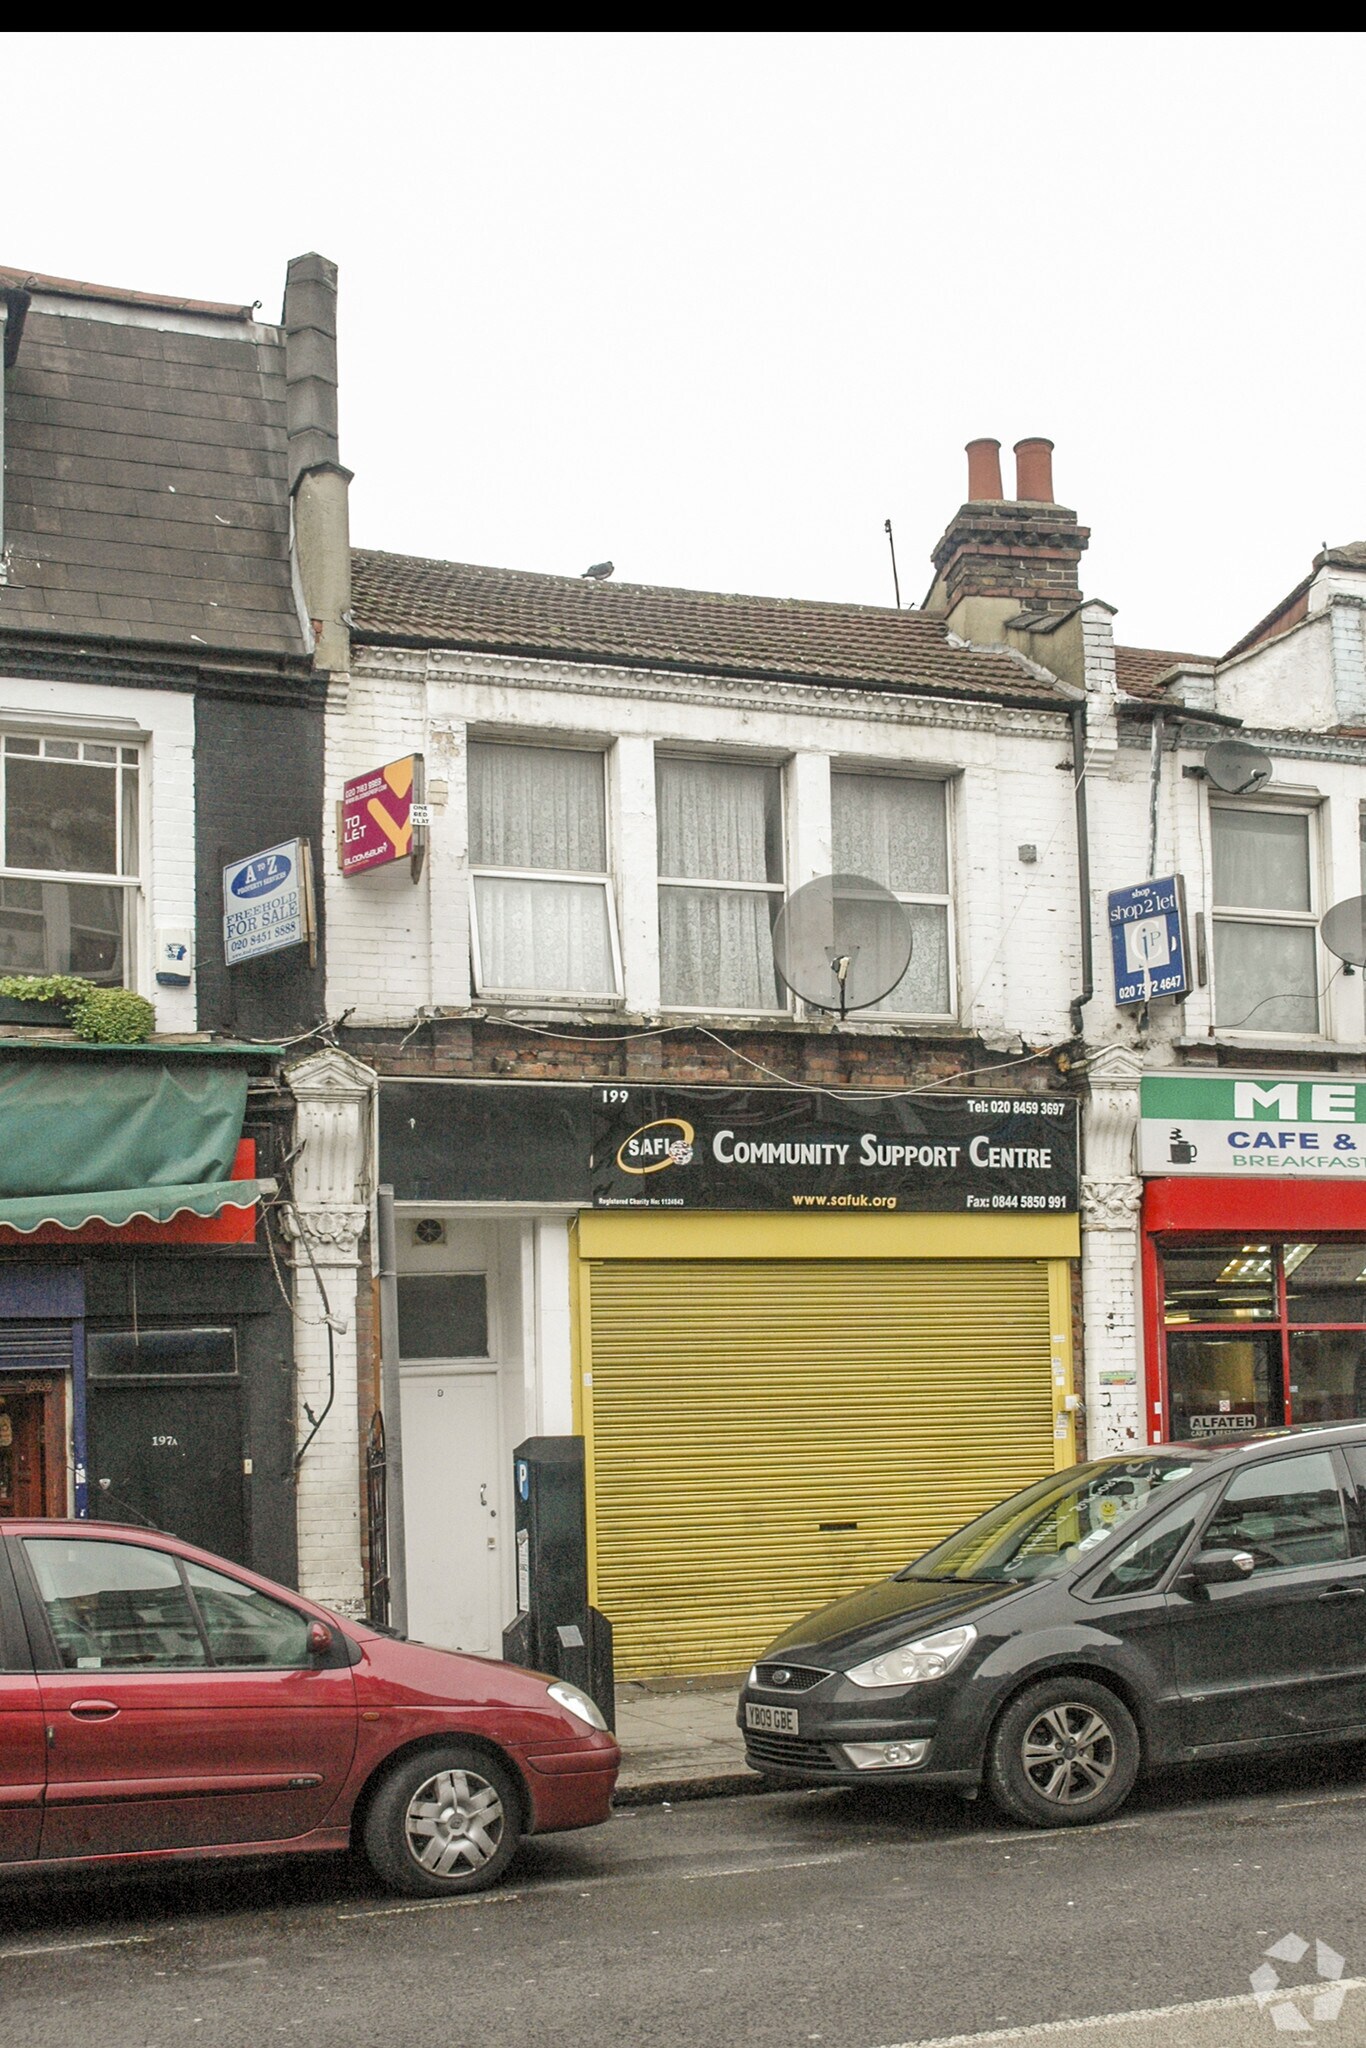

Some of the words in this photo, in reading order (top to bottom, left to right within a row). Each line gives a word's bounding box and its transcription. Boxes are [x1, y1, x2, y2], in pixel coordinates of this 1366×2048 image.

[345, 815, 360, 831] TO
[344, 825, 367, 843] LET
[344, 842, 389, 866] BLOOMSBURY
[245, 865, 257, 885] A
[266, 855, 278, 876] Z
[236, 880, 263, 896] PROPERTY
[226, 891, 297, 926] FREEHOLD
[227, 917, 258, 939] FOR
[262, 901, 298, 926] SALE
[231, 937, 248, 952] 020
[250, 930, 272, 946] 8451
[274, 920, 297, 938] 8888
[1119, 985, 1135, 999] 020
[1159, 975, 1181, 990] 4647
[602, 1090, 629, 1103] 199
[1233, 1081, 1357, 1122] ME
[967, 1100, 989, 1113] Tel:
[990, 1101, 1011, 1114] 020
[1013, 1101, 1039, 1115] 8459
[1040, 1102, 1066, 1116] 3697
[712, 1130, 850, 1165] COMMUNITY
[859, 1133, 961, 1168] SUPPORT
[968, 1135, 1052, 1169] CENTRE
[1227, 1131, 1320, 1150] CAFE
[1333, 1133, 1357, 1150] &
[599, 1197, 629, 1206] Registered
[629, 1198, 650, 1206] Charity
[792, 1194, 897, 1209] www.safuk.org
[966, 1195, 990, 1208] Fax:
[991, 1195, 1018, 1208] 0844
[1020, 1195, 1046, 1209] 5850
[1047, 1196, 1067, 1209] 991
[1192, 1416, 1255, 1428] ALFATEH
[518, 1464, 527, 1494] P
[749, 1705, 772, 1728] YB09
[774, 1710, 794, 1730] GBE
